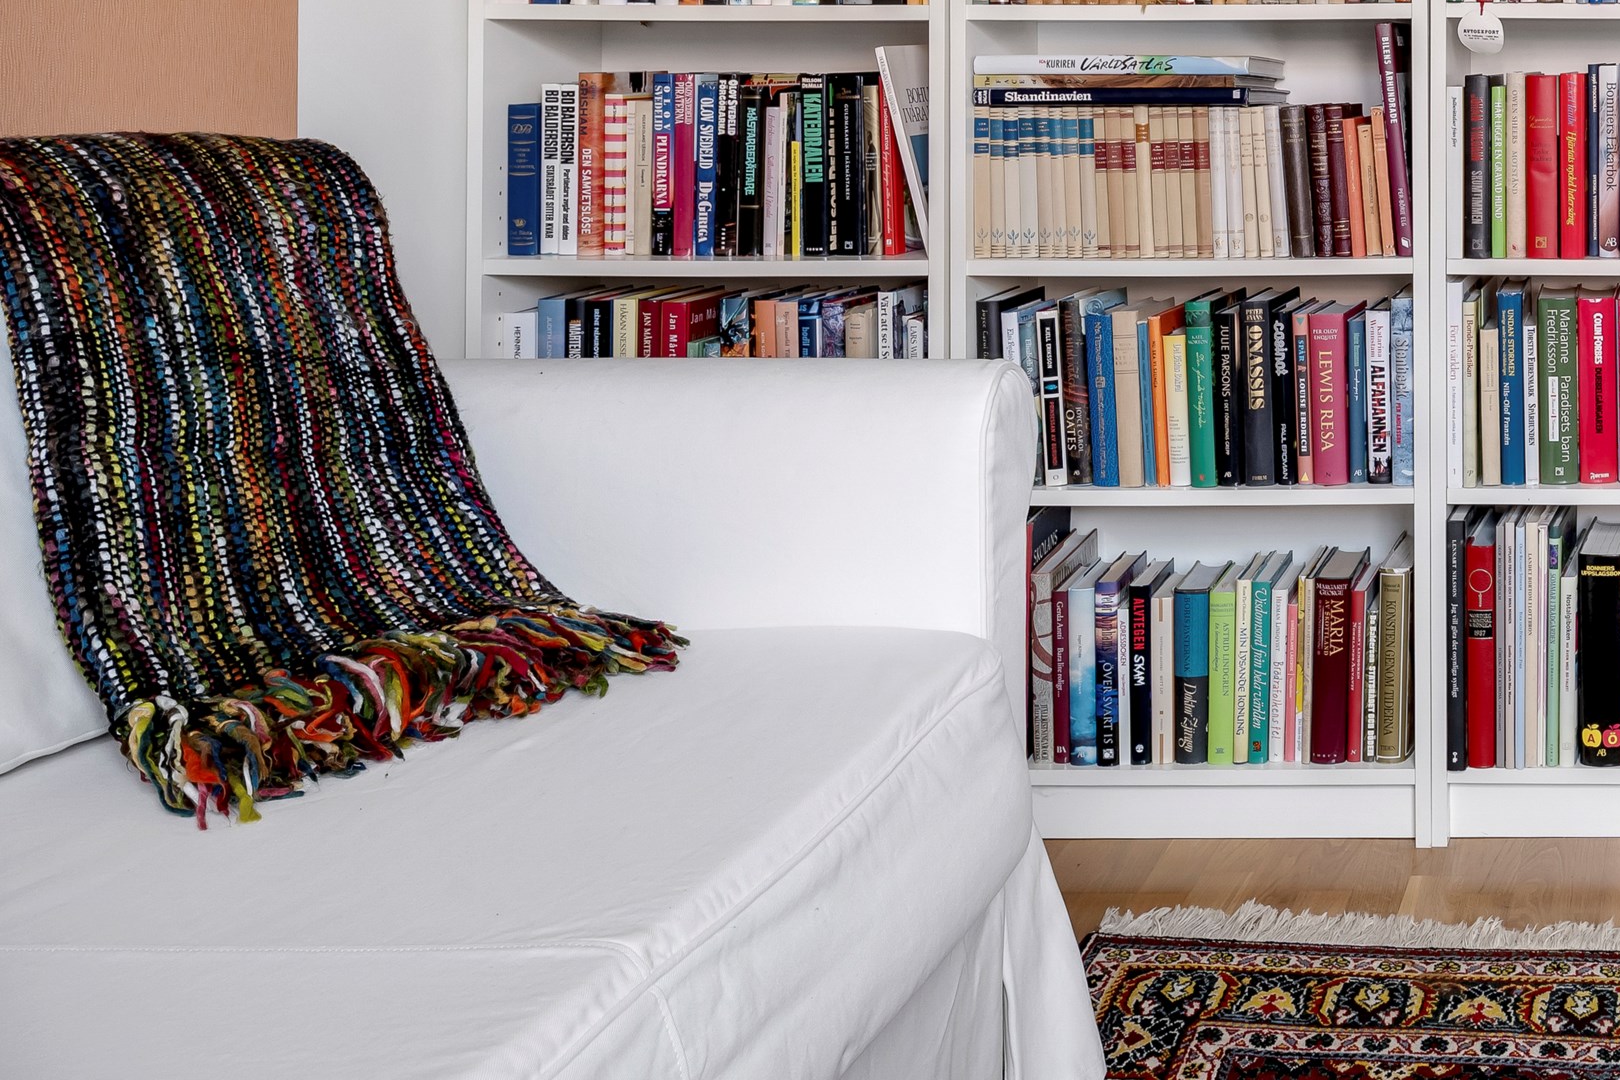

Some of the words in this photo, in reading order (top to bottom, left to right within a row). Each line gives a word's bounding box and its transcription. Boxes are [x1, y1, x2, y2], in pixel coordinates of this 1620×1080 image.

[1046, 60, 1076, 68] KURIREN
[1381, 36, 1392, 65] BILENS
[545, 90, 559, 103] BO
[561, 90, 574, 105] BO
[675, 82, 684, 124] PIRATERNA
[700, 98, 713, 122] OLOV
[1005, 91, 1092, 102] Skandinavien
[1385, 71, 1398, 124] ÅRHUNDRADE
[1606, 82, 1617, 134] Bonniers
[545, 105, 559, 160] BALDERSON
[561, 106, 574, 164] BALDERSON
[699, 124, 713, 169] SVEDELID
[744, 107, 757, 195] MÄSTARBERÄTTARE
[803, 93, 822, 182] KATEDRALEN
[582, 149, 591, 167] DEN
[656, 135, 667, 205] PLUNDRARNA
[1606, 137, 1616, 191] Läkarbok
[546, 165, 556, 200] STATSRÅDET
[582, 169, 592, 234] SAMVETSLÖSE
[1471, 170, 1483, 224] SKUMTIMMEN
[545, 202, 554, 221] SITTER
[545, 223, 553, 239] KVAR
[1221, 325, 1230, 351] JULIE
[1547, 309, 1558, 373] Fredriksson
[1560, 309, 1570, 363] Marianne
[1594, 313, 1603, 335] COLIN
[1249, 325, 1264, 409] ONASSIS
[1466, 320, 1474, 377] Bonde-Praktikan
[1594, 336, 1603, 364] FORBES
[1222, 354, 1230, 396] PARSONS
[1299, 378, 1307, 408] LOUISE
[1318, 351, 1333, 403] LEWIS
[1371, 365, 1386, 453] ALFAHANNEN
[1561, 376, 1571, 432] Paradisets
[1066, 409, 1077, 451] OATES
[1300, 412, 1308, 452] ERDRICH
[1320, 409, 1334, 451] RESA
[1562, 436, 1572, 462] barn
[1133, 598, 1145, 649] ALVTEGEN
[1254, 588, 1267, 646] Visdomsord
[1330, 600, 1344, 656] MARIA
[1384, 600, 1396, 646] KONSTEN
[1102, 663, 1115, 693] ÖVER
[1133, 654, 1145, 686] SKAM
[1251, 648, 1266, 668] från
[1384, 649, 1395, 690] GENOM
[1252, 670, 1265, 691] hela
[1102, 697, 1113, 730] SVART
[1252, 693, 1265, 729] världen
[1383, 693, 1394, 736] TIDERNA
[1104, 734, 1113, 744] IS
